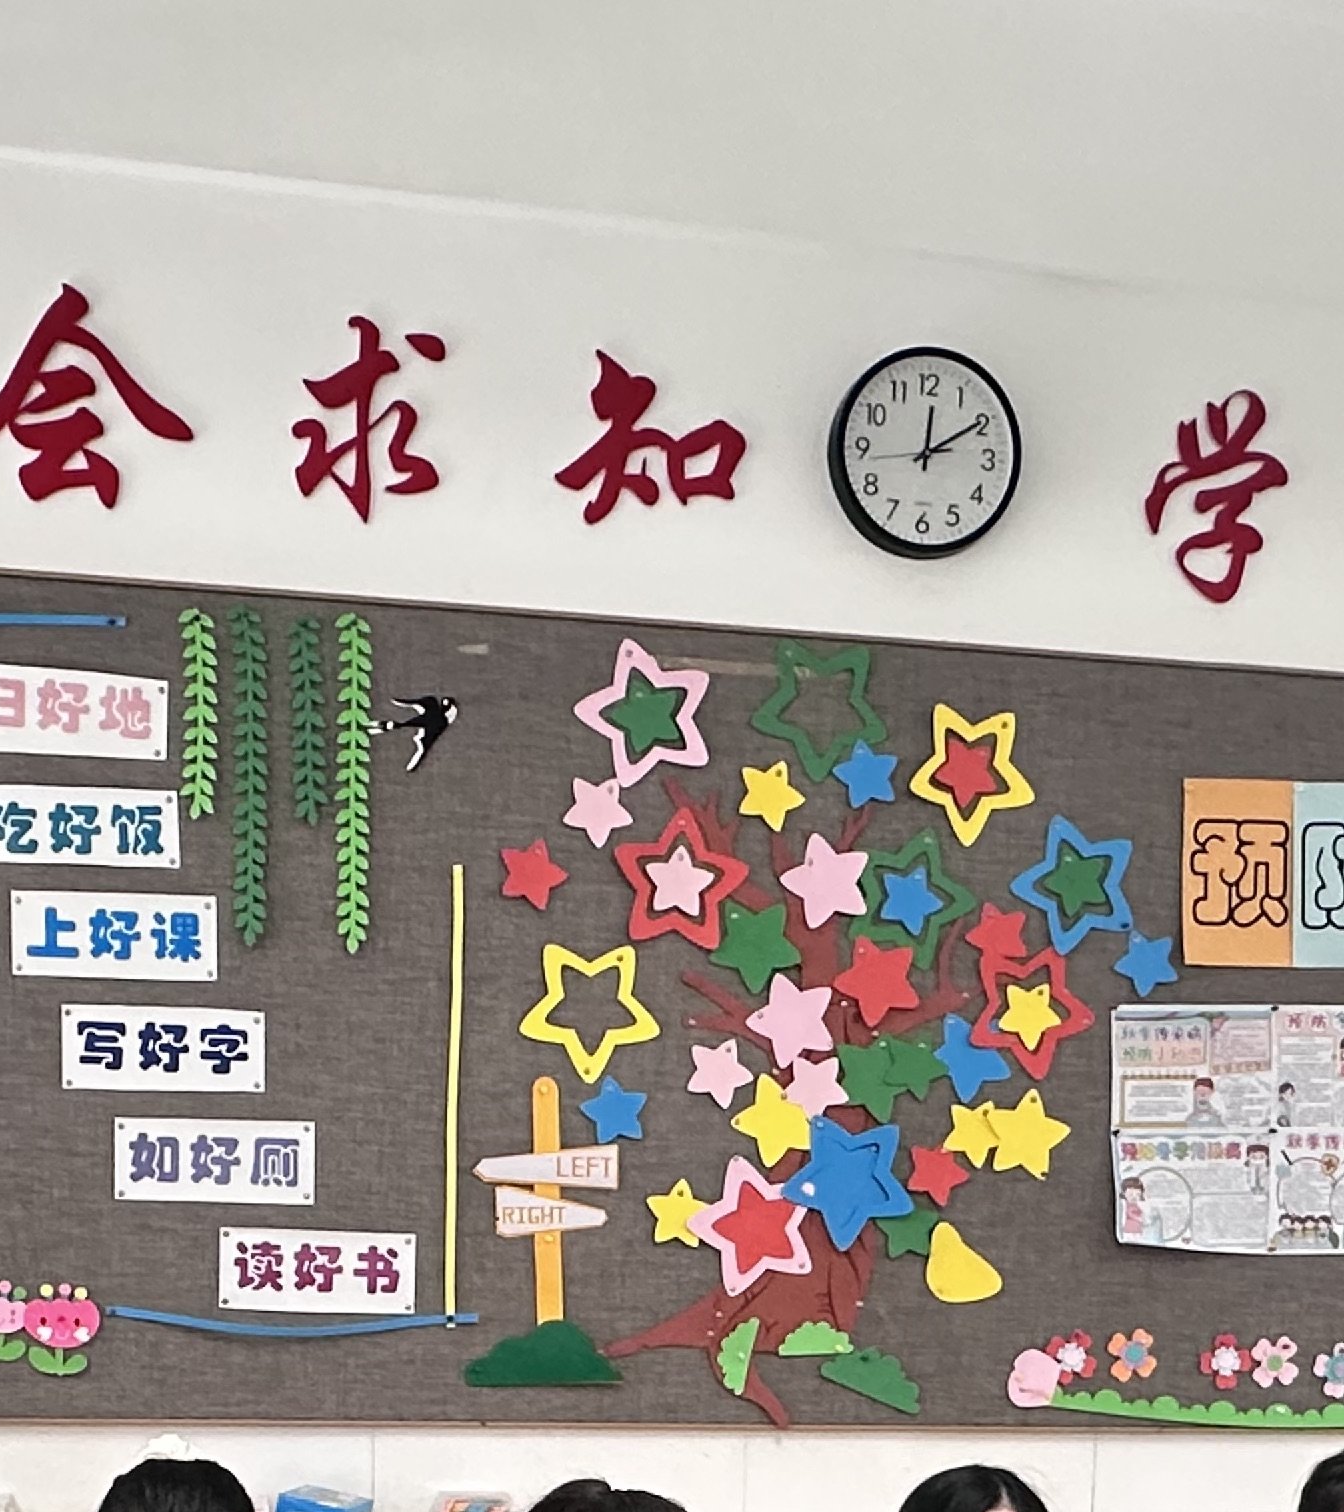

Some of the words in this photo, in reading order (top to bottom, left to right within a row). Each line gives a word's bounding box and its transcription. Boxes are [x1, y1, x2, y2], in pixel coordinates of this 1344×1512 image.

[890, 380, 908, 404] 11
[918, 373, 940, 398] 12
[956, 385, 964, 410] 1
[866, 402, 887, 427] 10
[975, 412, 990, 436] 2
[855, 436, 871, 460] 9
[980, 448, 996, 472] 3
[863, 473, 878, 496] 8
[969, 483, 984, 505] 4
[886, 498, 900, 521] 7
[945, 504, 960, 527] 5
[914, 511, 930, 534] 6
[27, 907, 205, 964] 上好课
[77, 1022, 250, 1074] 写好字
[128, 1134, 301, 1187] 如好厕
[556, 1156, 613, 1178] LEFT
[502, 1206, 566, 1224] RIGHT
[234, 1242, 401, 1295] 读好书
